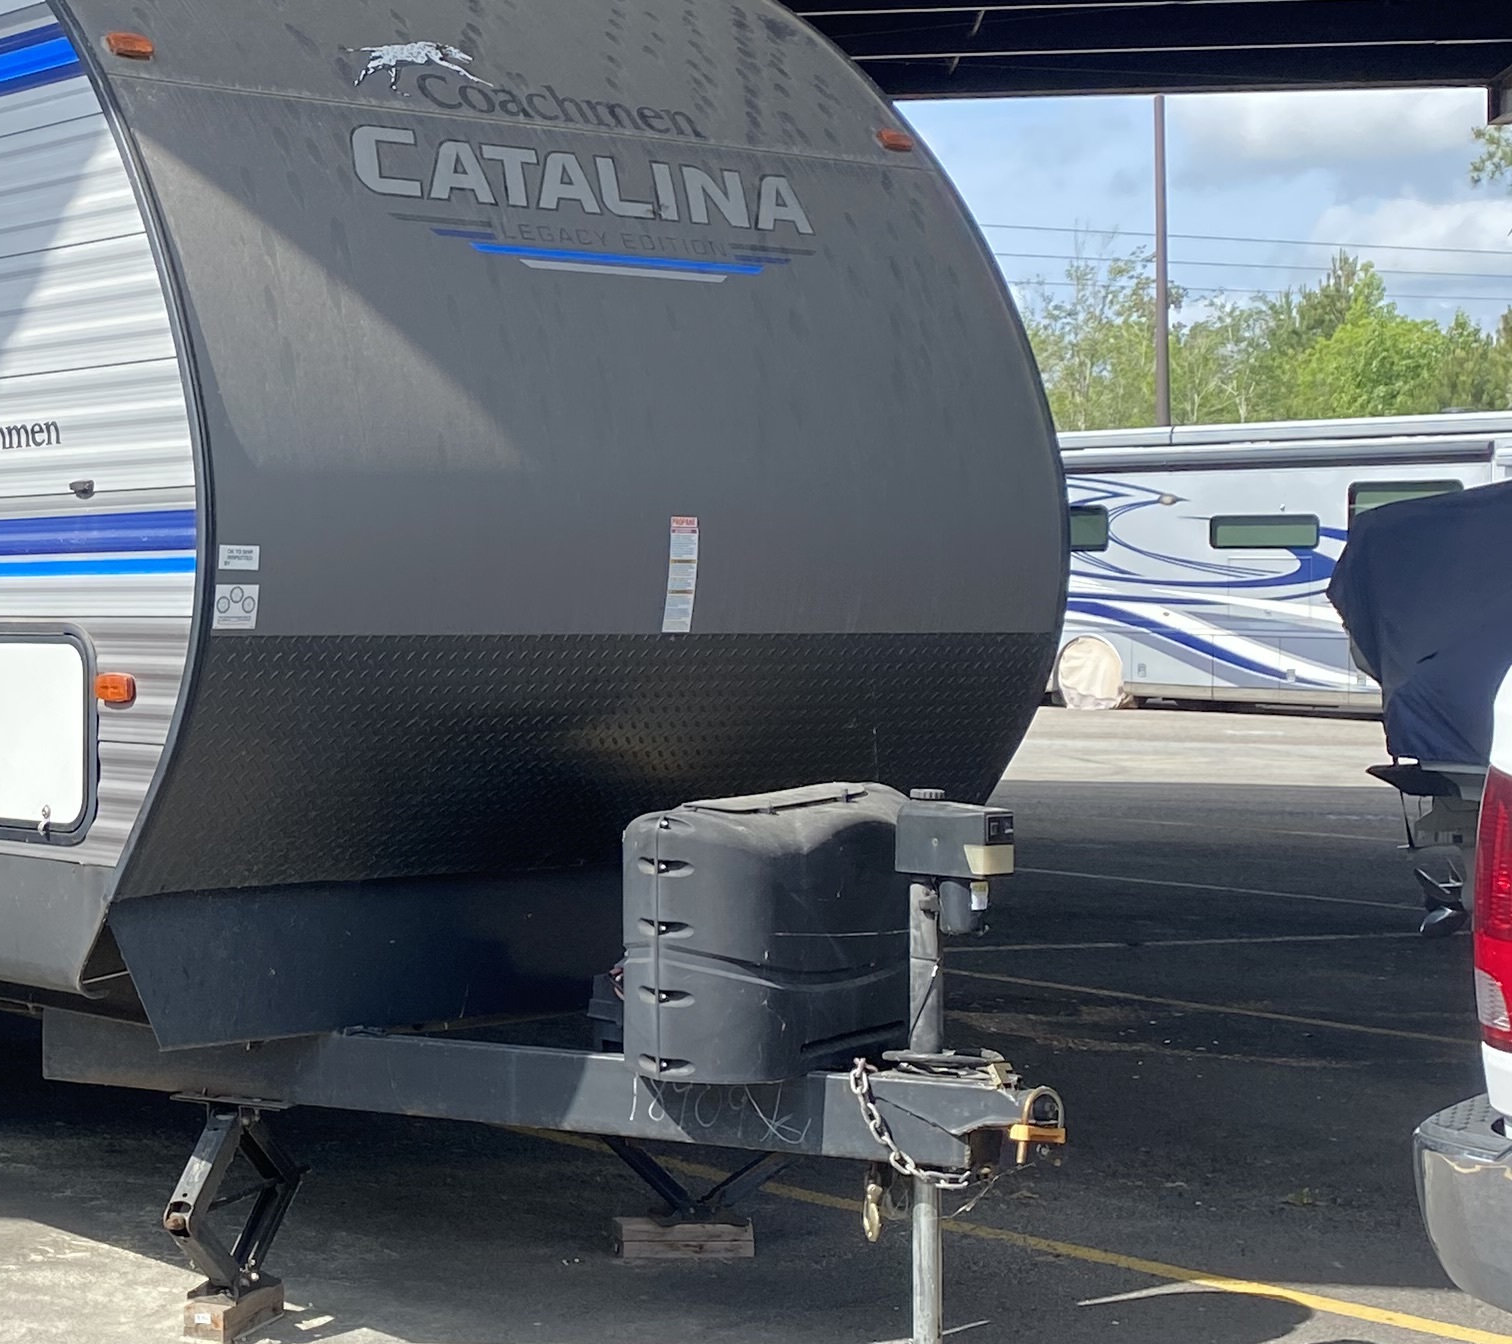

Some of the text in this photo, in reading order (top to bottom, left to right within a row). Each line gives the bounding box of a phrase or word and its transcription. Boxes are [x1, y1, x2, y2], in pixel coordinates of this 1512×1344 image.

[416, 73, 708, 139] Coachmen
[350, 124, 816, 236] CATALINA
[500, 222, 728, 257] LEGACY EDITION
